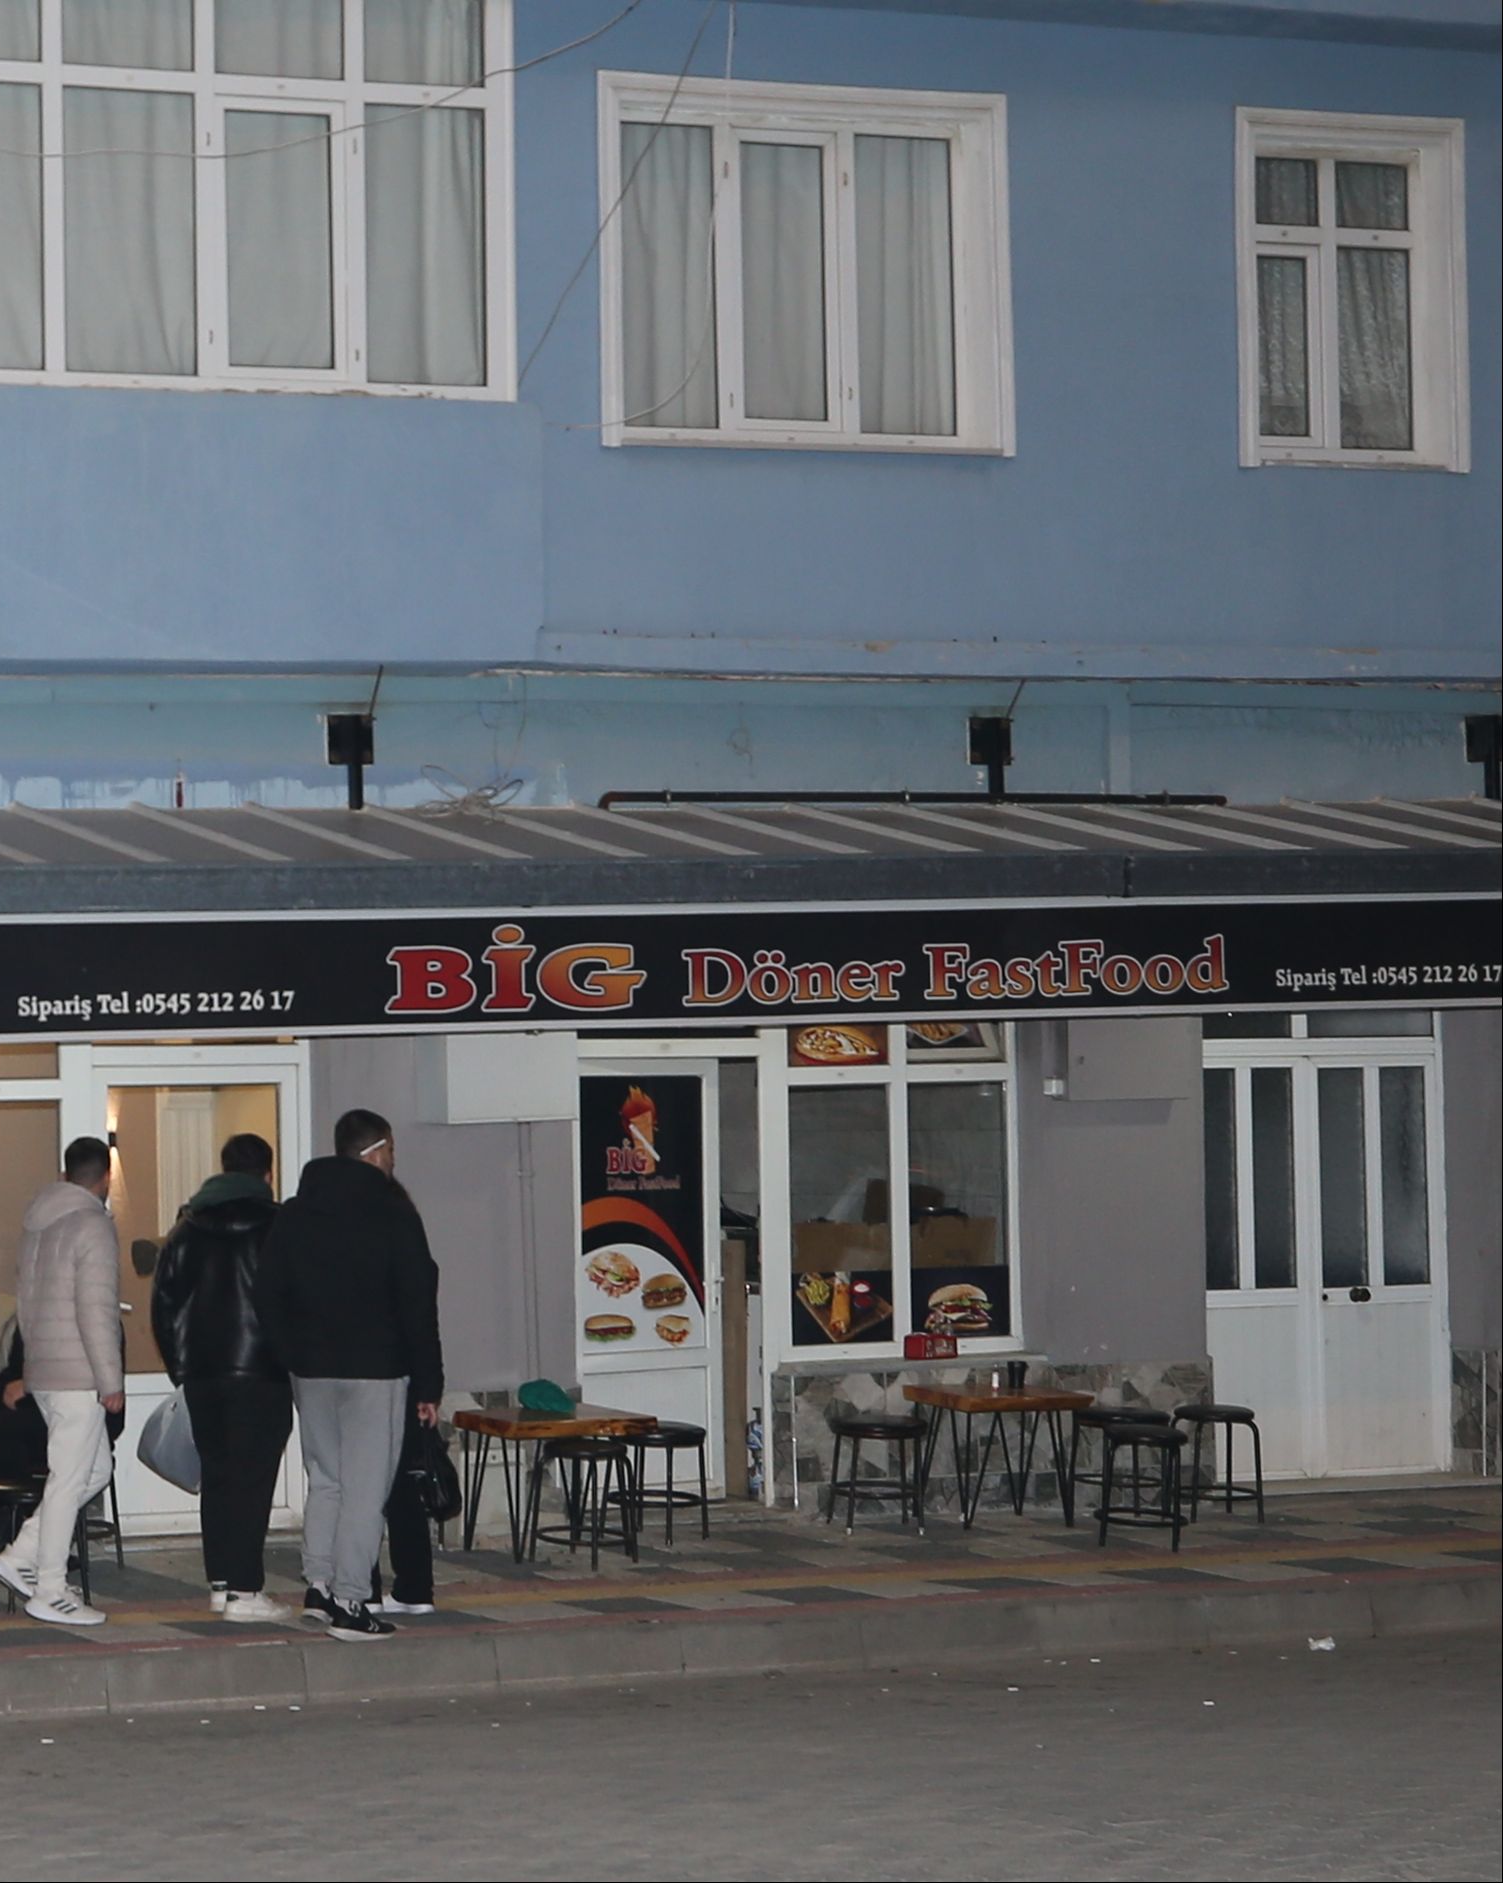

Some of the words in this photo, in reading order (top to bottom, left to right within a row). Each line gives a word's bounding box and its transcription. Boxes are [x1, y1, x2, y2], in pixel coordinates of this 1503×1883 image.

[682, 949, 905, 1007] Döner
[923, 933, 1229, 1000] FastFood
[1275, 967, 1337, 992] Sipariş
[1340, 964, 1368, 986] Tel
[1372, 966, 1418, 986] :0545
[1423, 965, 1453, 983] 212
[1458, 963, 1478, 983] 26
[1483, 965, 1502, 983] 17
[18, 995, 92, 1022] Sipariş
[96, 991, 130, 1014] Tel
[135, 993, 191, 1015] :0545
[197, 992, 234, 1013] 212
[240, 988, 265, 1011] 26
[270, 990, 294, 1011] 17
